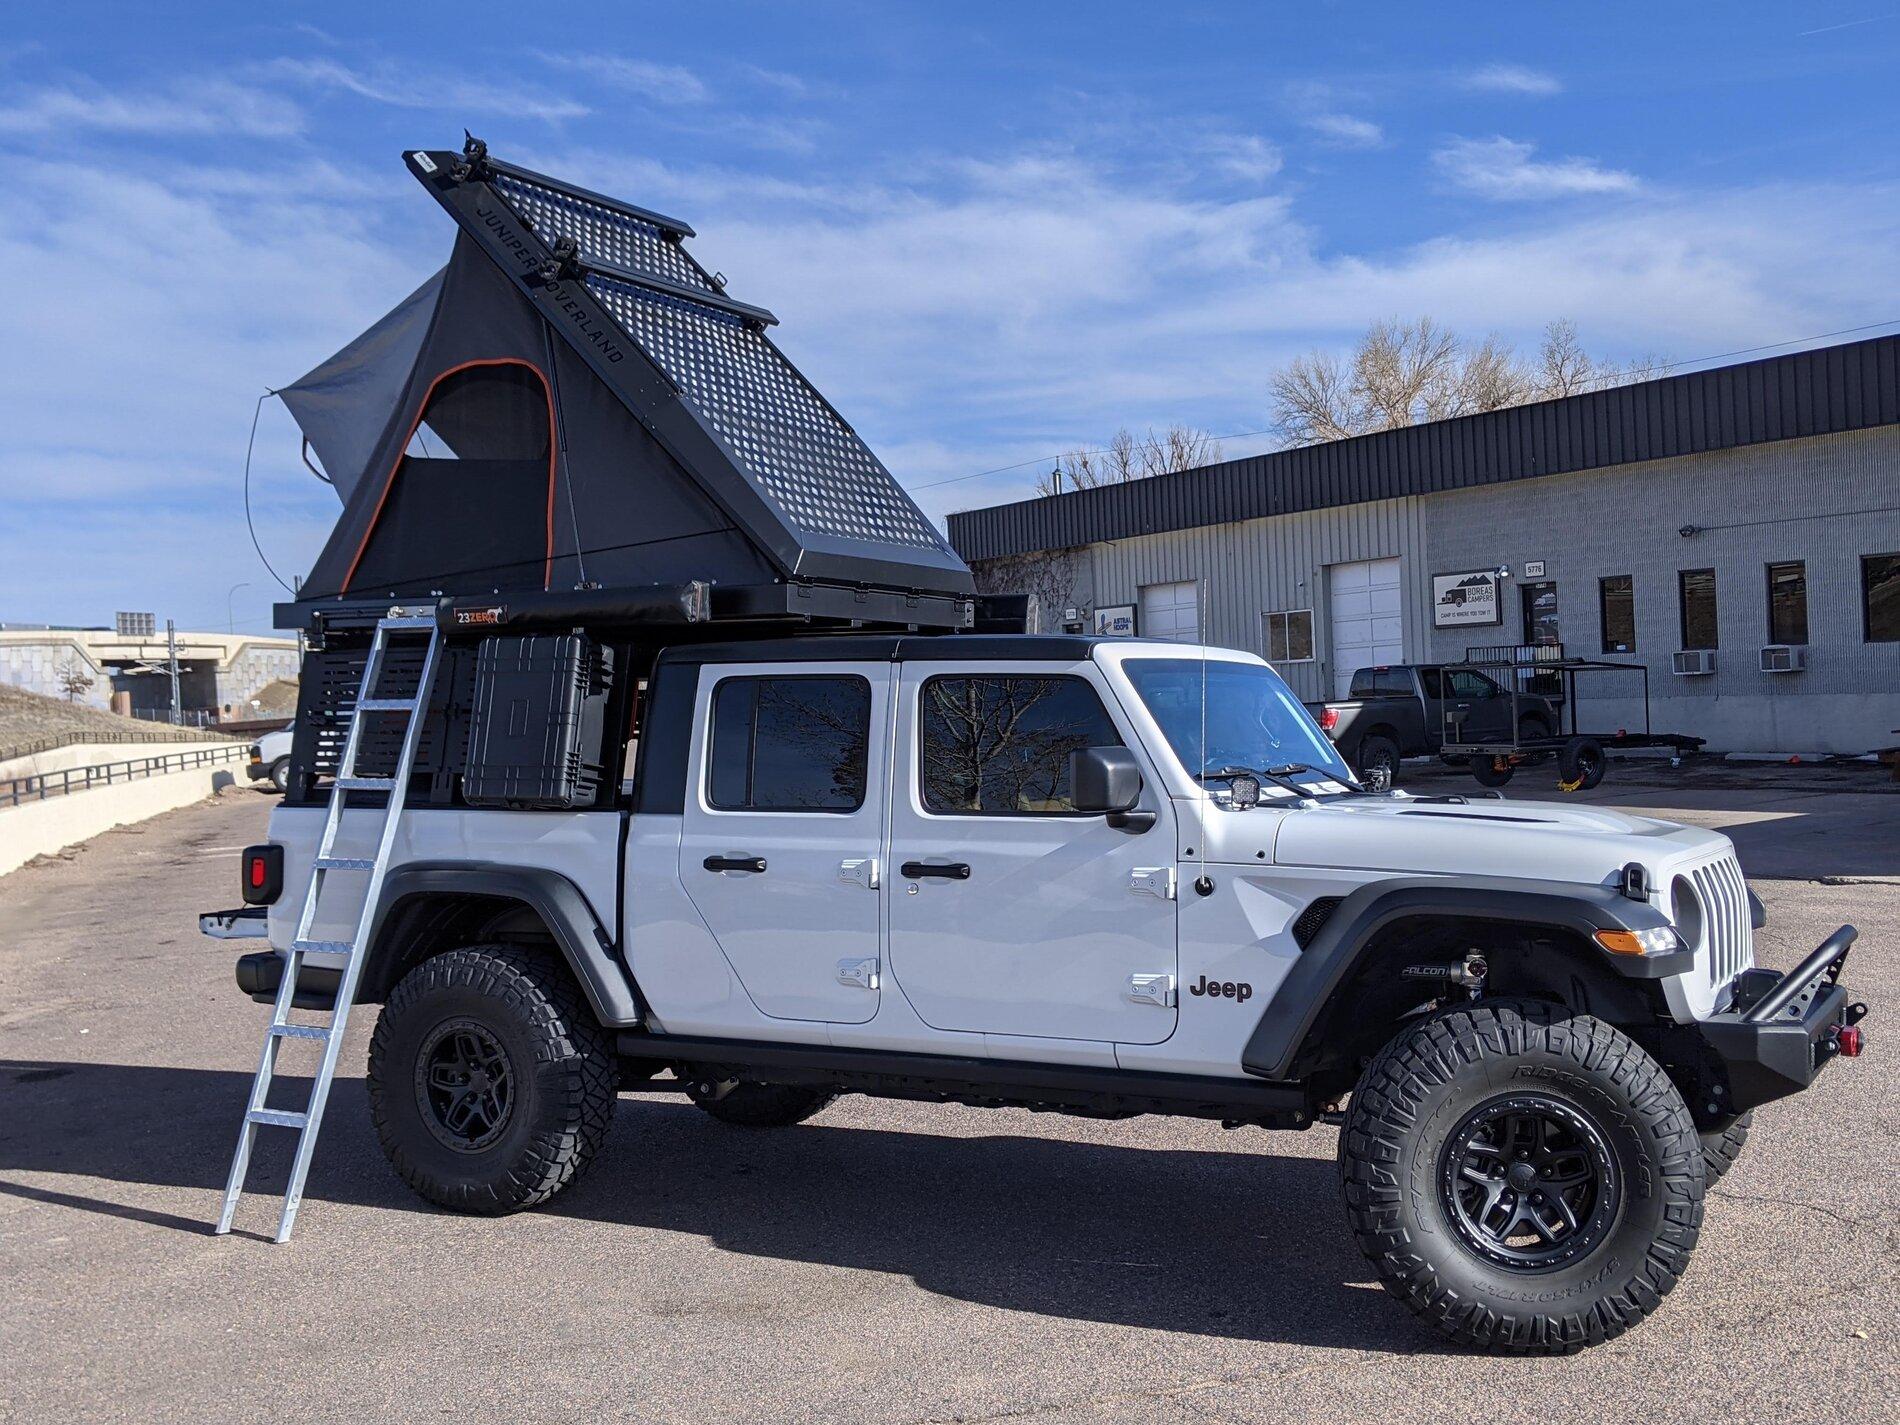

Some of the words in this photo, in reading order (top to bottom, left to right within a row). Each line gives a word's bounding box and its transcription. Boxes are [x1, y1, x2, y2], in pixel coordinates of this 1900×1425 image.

[476, 207, 540, 273] JUNIPER
[545, 281, 624, 364] OVERLAND
[1527, 565, 1542, 574] 5776
[1467, 586, 1493, 596] BOREAS
[1467, 595, 1494, 604] CAMPERS
[457, 611, 497, 624] 23ZERO
[1402, 966, 1446, 975] FALCON
[1189, 975, 1253, 1003] Jeep
